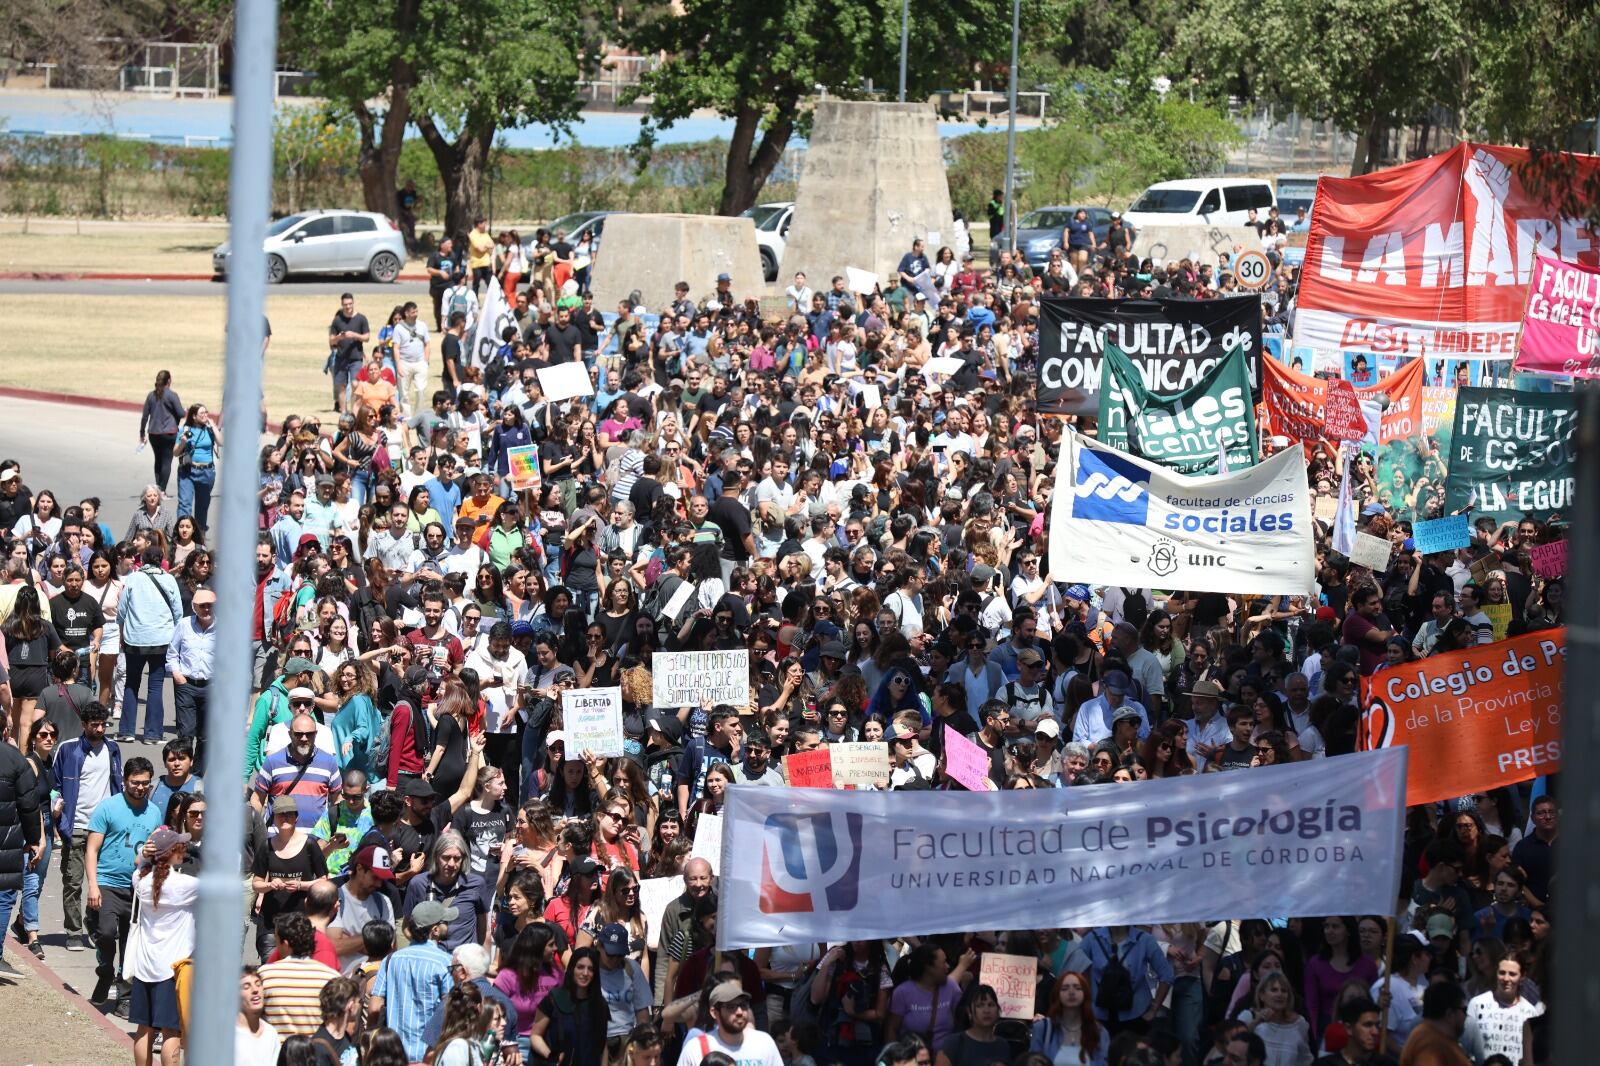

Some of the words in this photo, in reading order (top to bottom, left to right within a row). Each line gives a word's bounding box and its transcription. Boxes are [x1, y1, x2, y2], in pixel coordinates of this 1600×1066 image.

[1241, 260, 1264, 278] 30
[1320, 231, 1406, 286] LA
[1550, 299, 1569, 326] de
[1060, 321, 1212, 356] FACULTAD
[1221, 325, 1253, 351] de
[1344, 319, 1410, 353] MST
[1433, 331, 1520, 353] INDEPE
[1313, 386, 1324, 396] DE
[1460, 445, 1474, 463] DE
[1166, 494, 1221, 508] facultad
[1226, 496, 1241, 508] de
[1245, 492, 1294, 506] ciencias
[1479, 481, 1507, 512] LA
[1164, 509, 1294, 534] sociales
[1188, 551, 1227, 568] unc
[667, 672, 712, 689] DERECHOS
[715, 670, 732, 687] QUE
[1387, 660, 1493, 703] Colegio
[1502, 649, 1536, 677] de
[575, 698, 611, 708] LIBERTAD
[1405, 711, 1430, 730] de
[1434, 704, 1453, 724] la
[1458, 681, 1553, 719] Provincia
[1505, 715, 1541, 737] Ley
[1498, 740, 1561, 774] PRES
[835, 769, 844, 778] AL
[849, 769, 887, 778] PRESIDENTE
[893, 822, 1064, 860] Facultad
[1081, 820, 1130, 852] de
[1146, 799, 1362, 849] Psicología
[890, 867, 1056, 889] UNIVERSIDAD
[1070, 856, 1189, 885] NACIONAL
[1203, 850, 1232, 868] DE
[1245, 846, 1364, 866] CÓRDOBA
